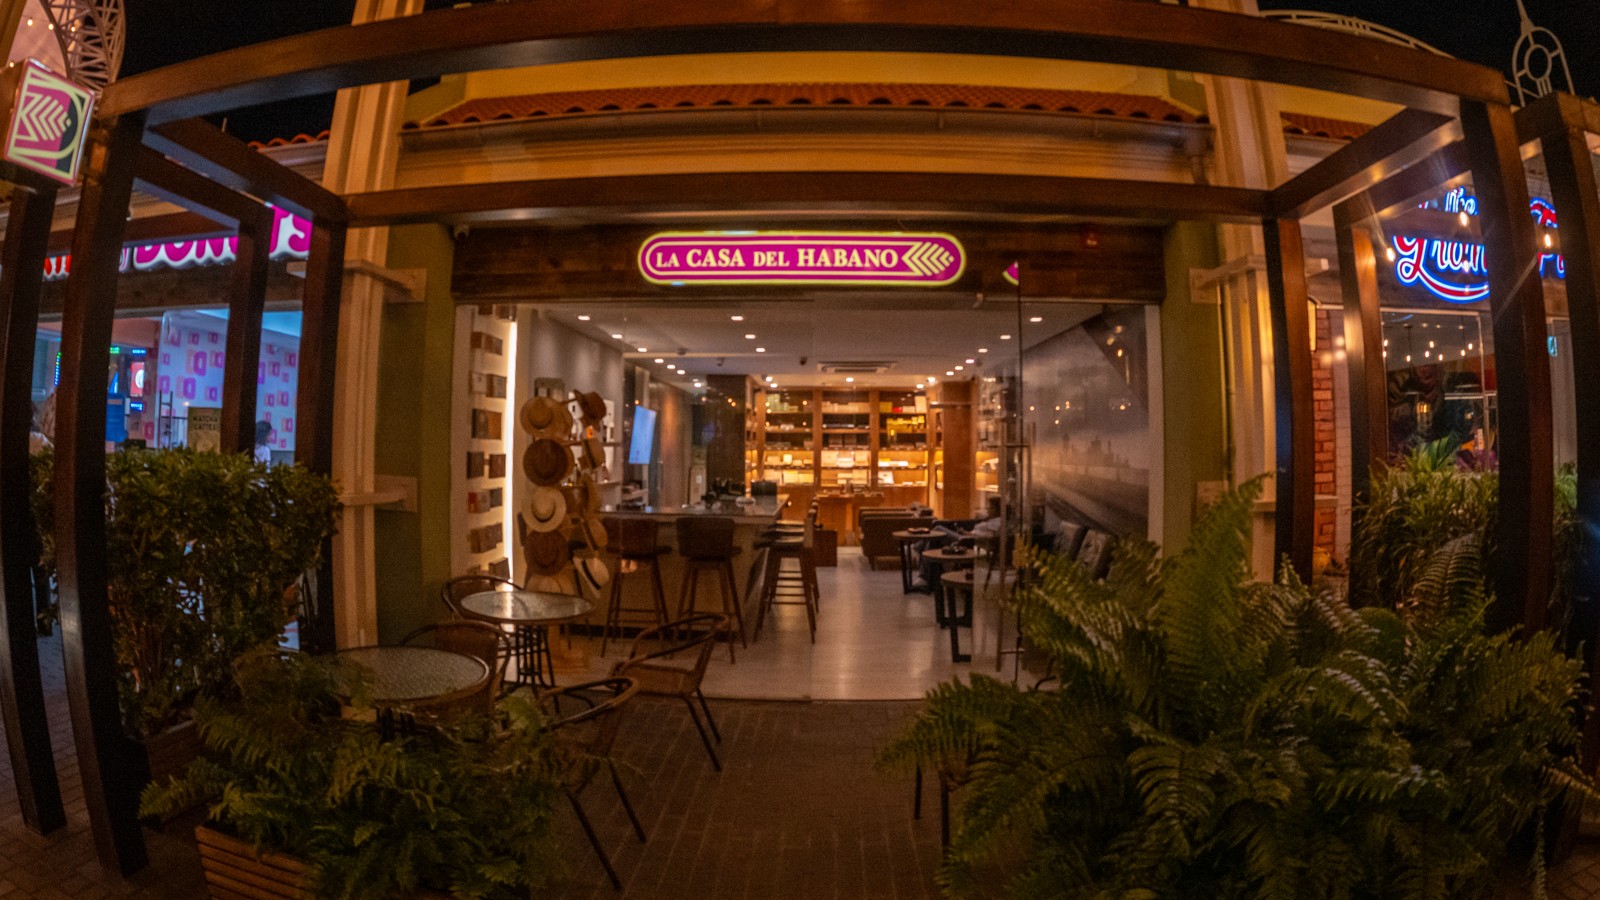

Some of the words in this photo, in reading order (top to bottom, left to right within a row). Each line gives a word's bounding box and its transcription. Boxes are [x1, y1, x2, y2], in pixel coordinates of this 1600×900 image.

[656, 252, 680, 267] LA
[686, 248, 746, 267] CASA
[753, 251, 790, 267] DEL
[797, 248, 899, 268] HABANO
